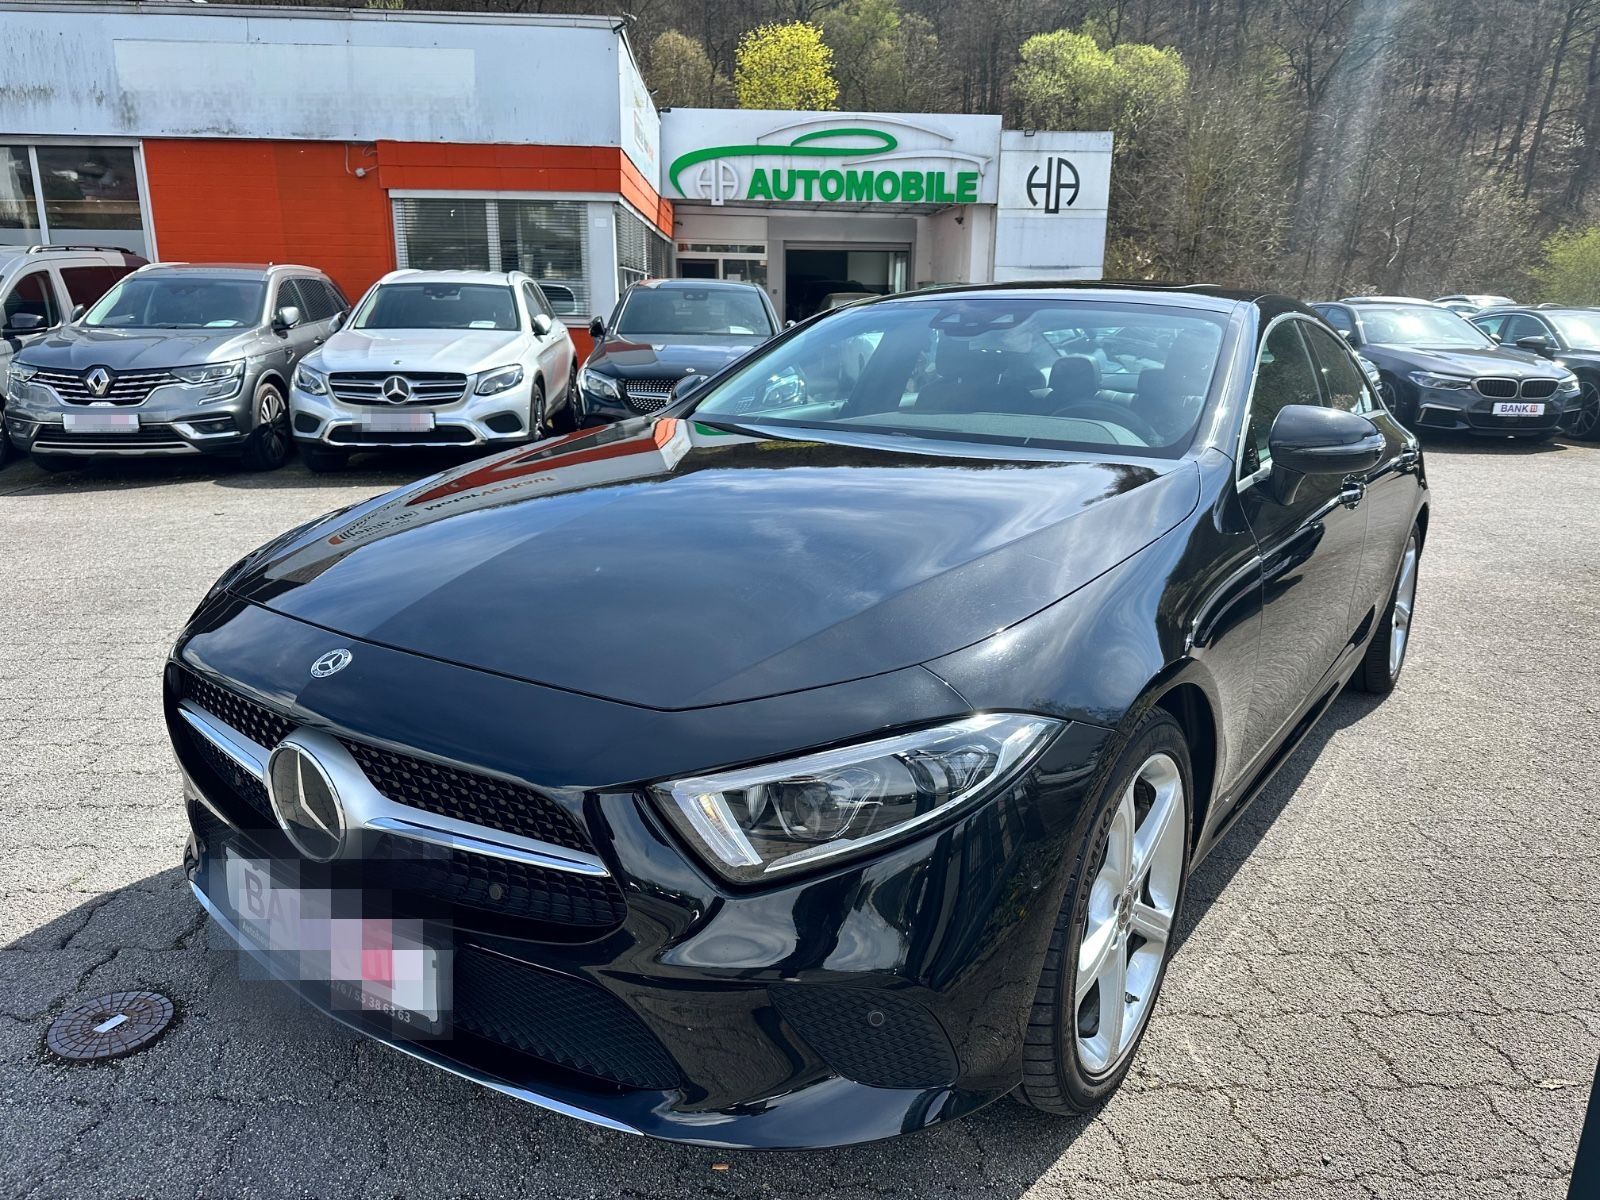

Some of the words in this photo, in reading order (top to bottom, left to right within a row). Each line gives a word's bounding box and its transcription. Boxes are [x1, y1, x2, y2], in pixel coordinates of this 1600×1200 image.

[747, 168, 978, 203] AUTOMOBILE
[1501, 404, 1529, 412] BANK
[1075, 807, 1112, 925] KUMHO
[368, 995, 382, 1011] 38
[382, 1001, 396, 1017] 63
[397, 1008, 411, 1023] 63
